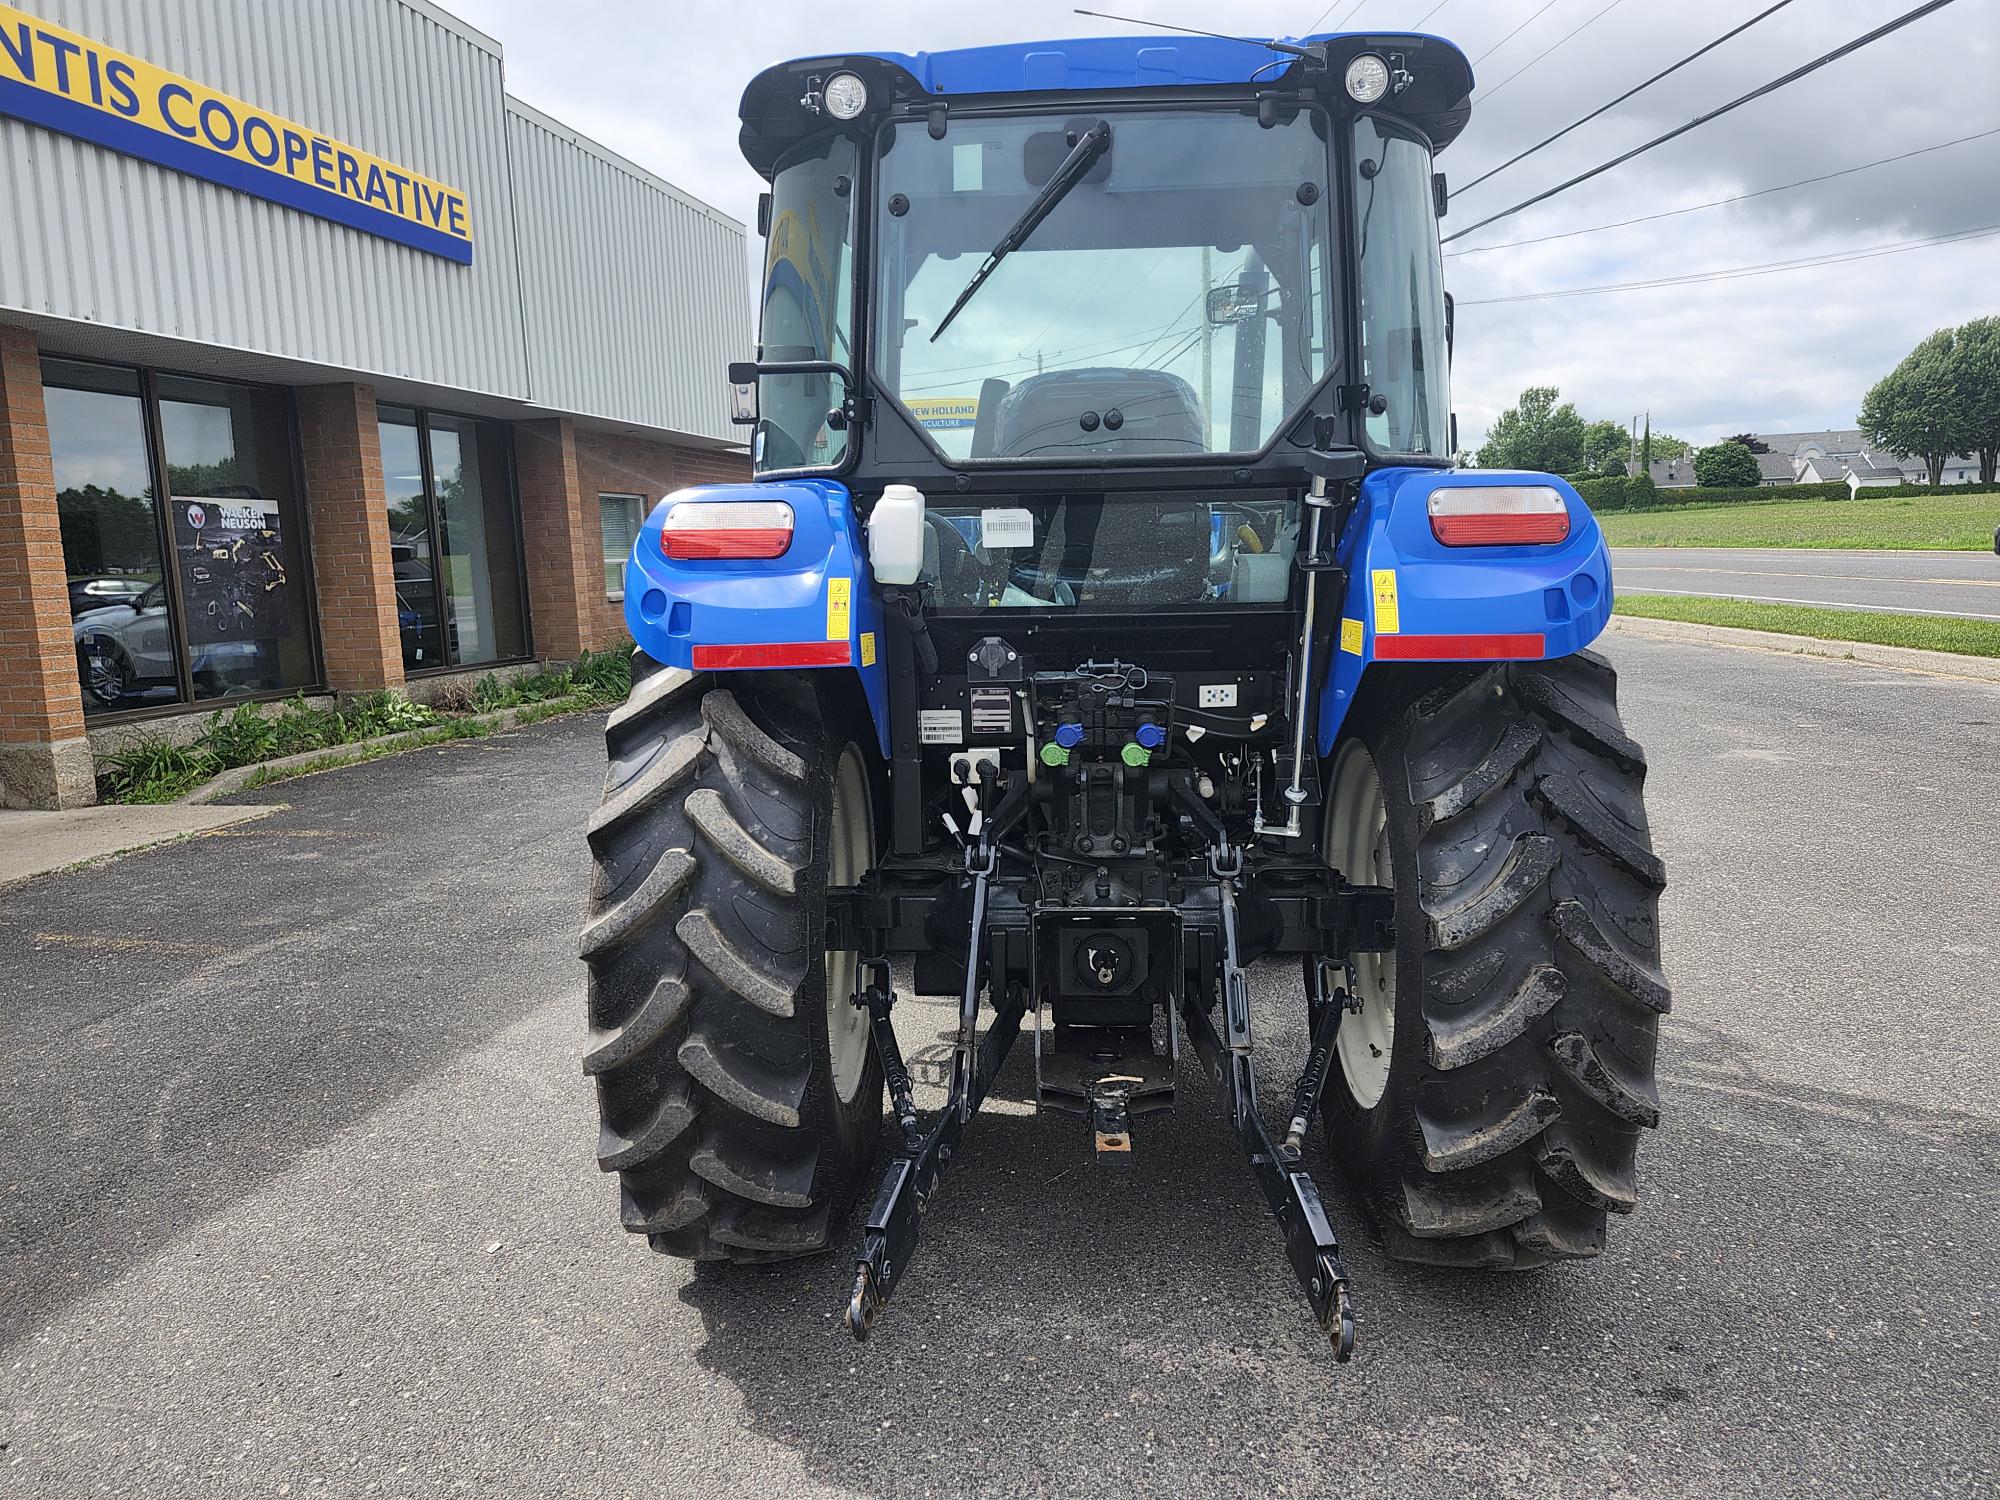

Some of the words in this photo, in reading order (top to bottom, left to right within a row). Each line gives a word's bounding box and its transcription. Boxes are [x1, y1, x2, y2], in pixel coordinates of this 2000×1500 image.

[0, 22, 140, 117] NTIS
[158, 83, 467, 237] COOPÉRATIVE
[932, 406, 974, 415] HOLLAND
[218, 506, 266, 519] WACKER
[221, 518, 267, 530] NEUSON
